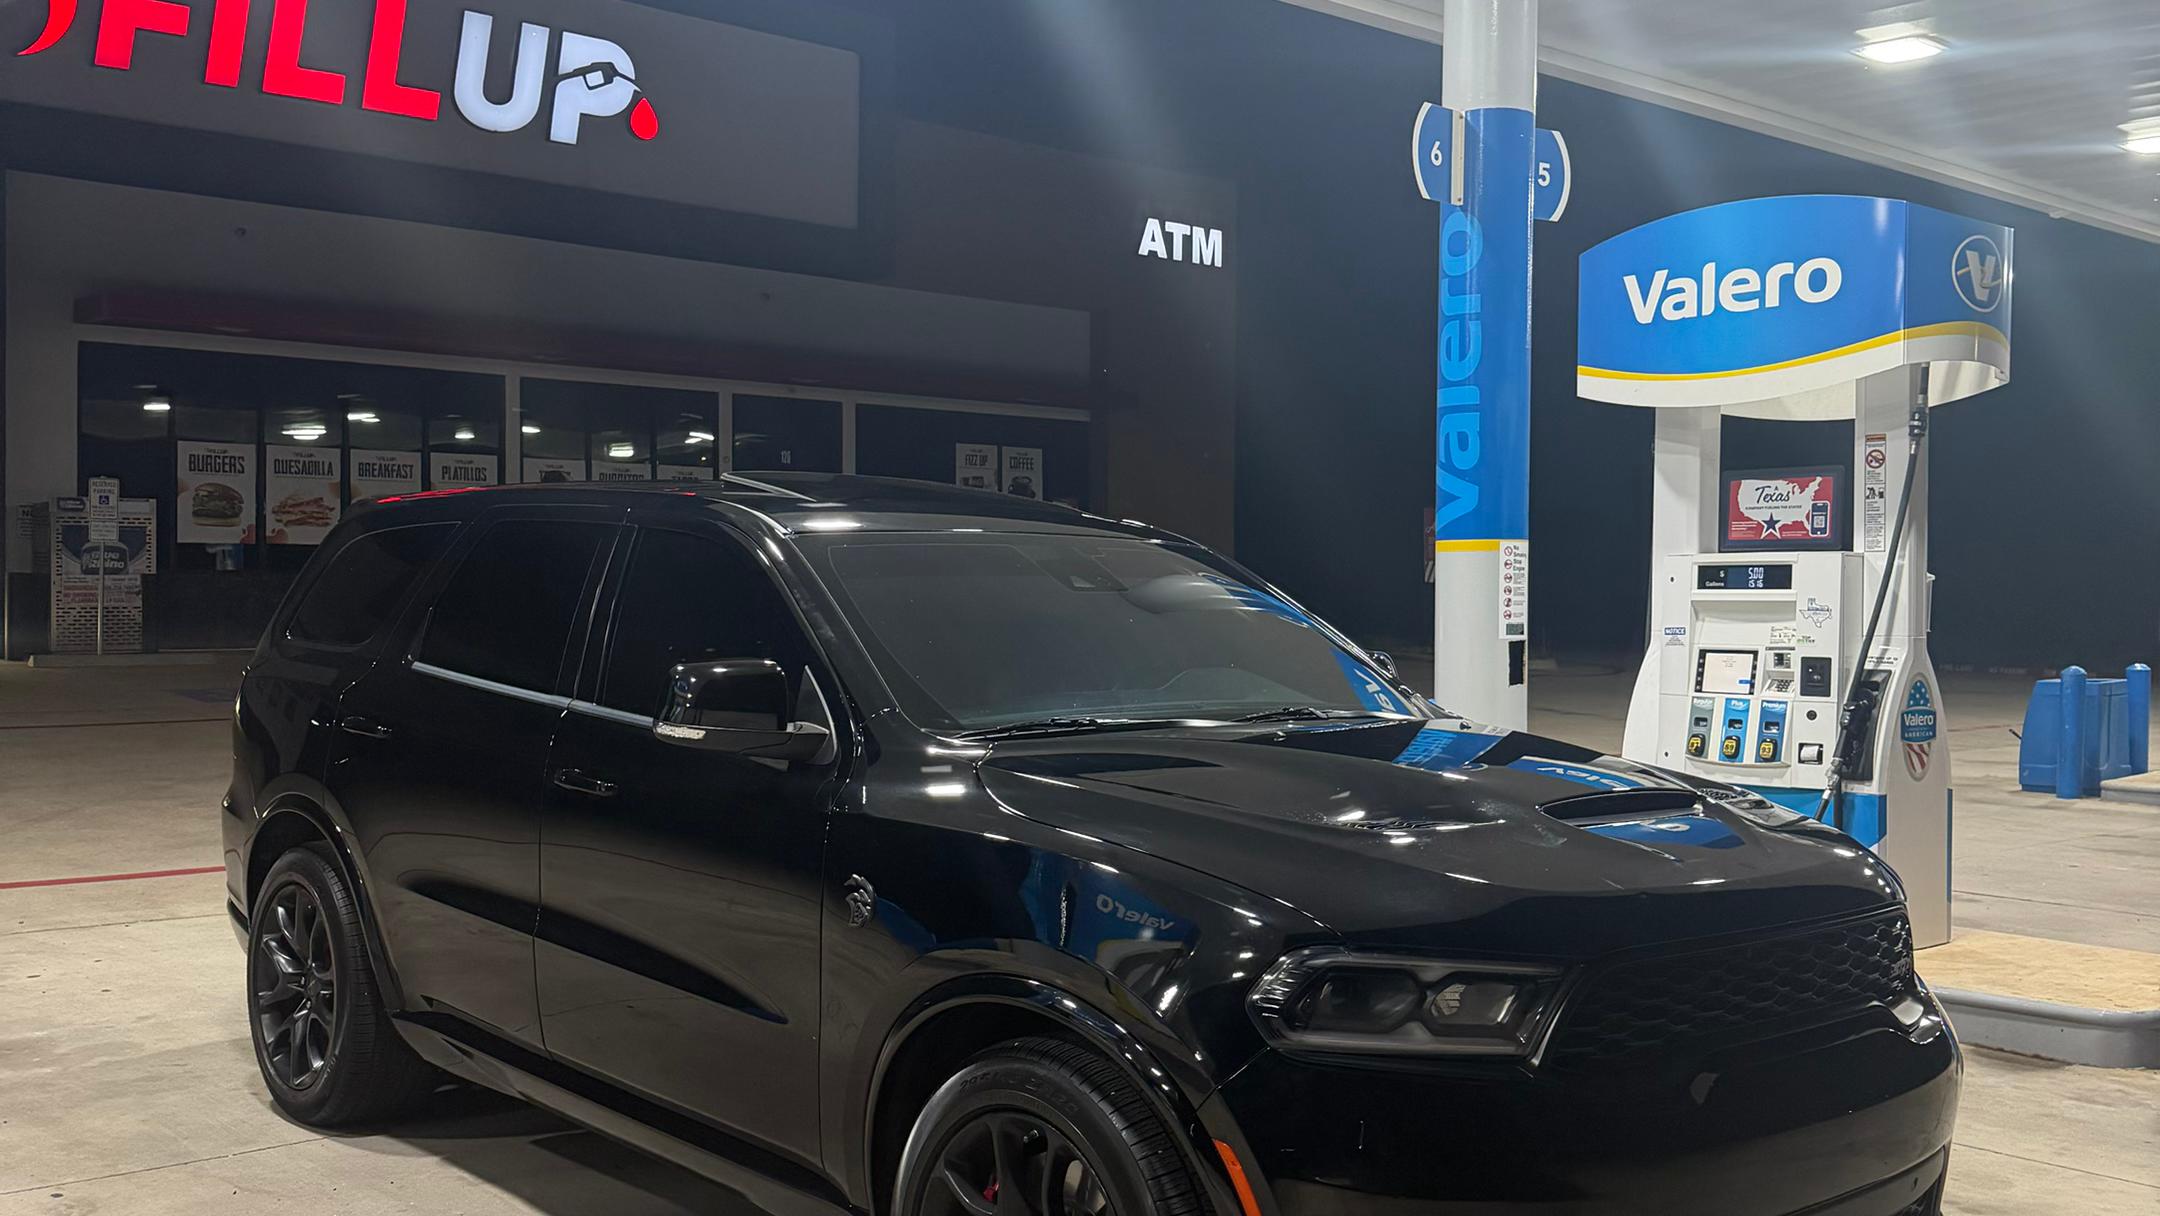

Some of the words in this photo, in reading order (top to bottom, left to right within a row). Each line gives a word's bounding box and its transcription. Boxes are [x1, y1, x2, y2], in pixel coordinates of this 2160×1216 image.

[1430, 141, 1442, 165] 6
[1537, 163, 1551, 186] 5
[1138, 218, 1223, 267] ATM
[1623, 256, 1842, 325] Valero
[1435, 206, 1483, 532] Valero
[188, 453, 245, 474] BURGERS
[274, 458, 334, 477] QUESADILLA
[965, 454, 979, 466] FIZZ
[980, 455, 988, 467] UP
[1009, 456, 1034, 471] COFFEE
[358, 462, 414, 479] BREAKFAST
[441, 465, 487, 482] PLATILLOS
[1755, 485, 1791, 504] Texas
[1719, 570, 1725, 578] $
[1903, 713, 1934, 726] Valero
[1725, 743, 1734, 751] 89
